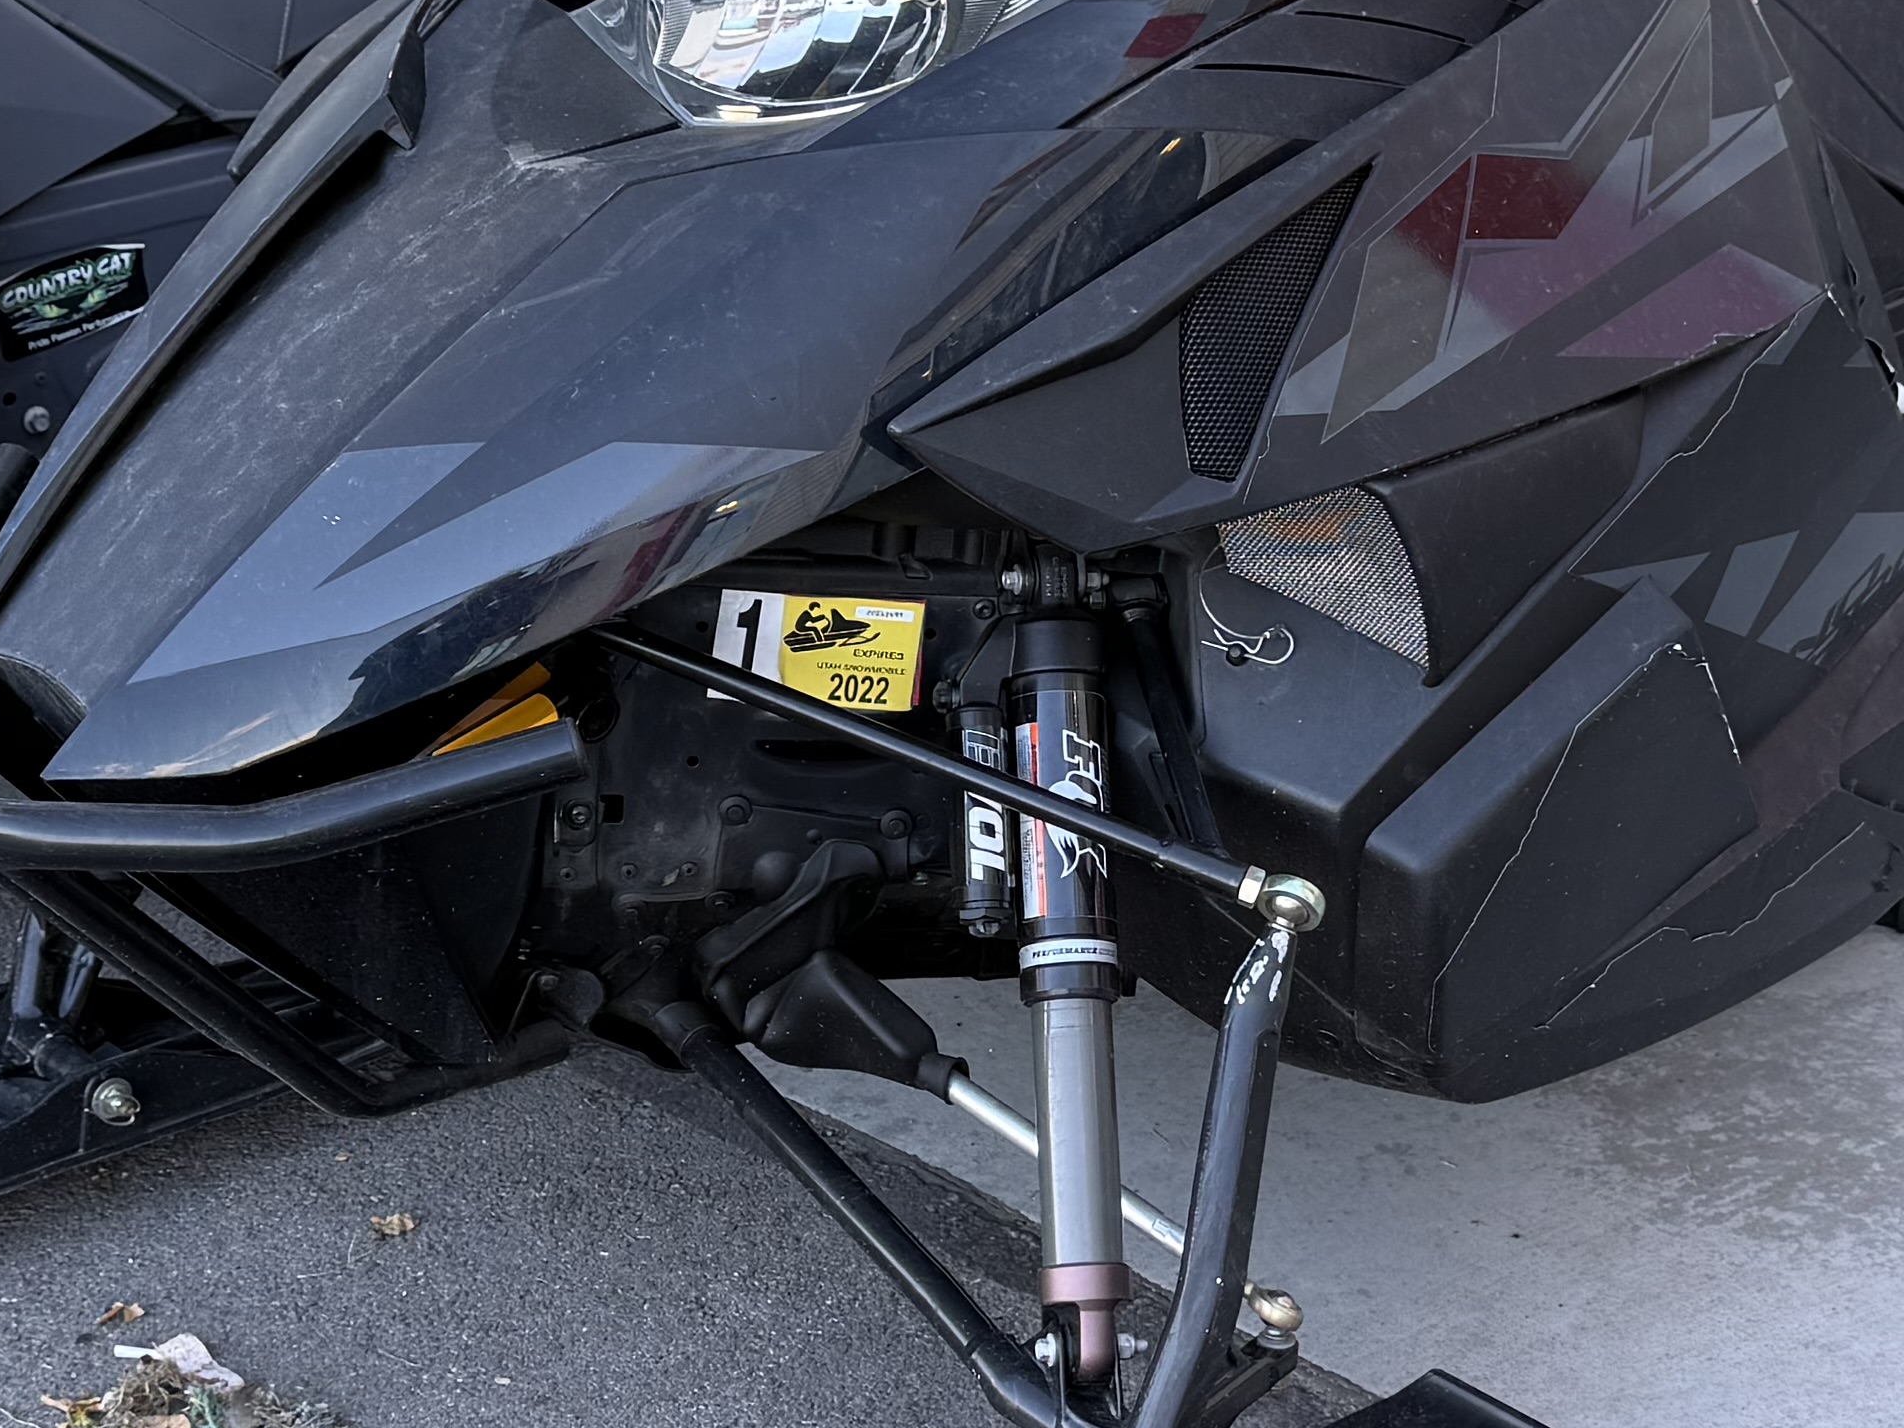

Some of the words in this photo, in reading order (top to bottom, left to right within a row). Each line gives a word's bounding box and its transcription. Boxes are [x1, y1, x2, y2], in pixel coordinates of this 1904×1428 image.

[1, 265, 93, 309] COUNTRY
[96, 251, 133, 277] CAT
[816, 661, 842, 670] UTAH
[842, 663, 908, 676] SNOWMOBILE
[827, 672, 890, 705] 2022
